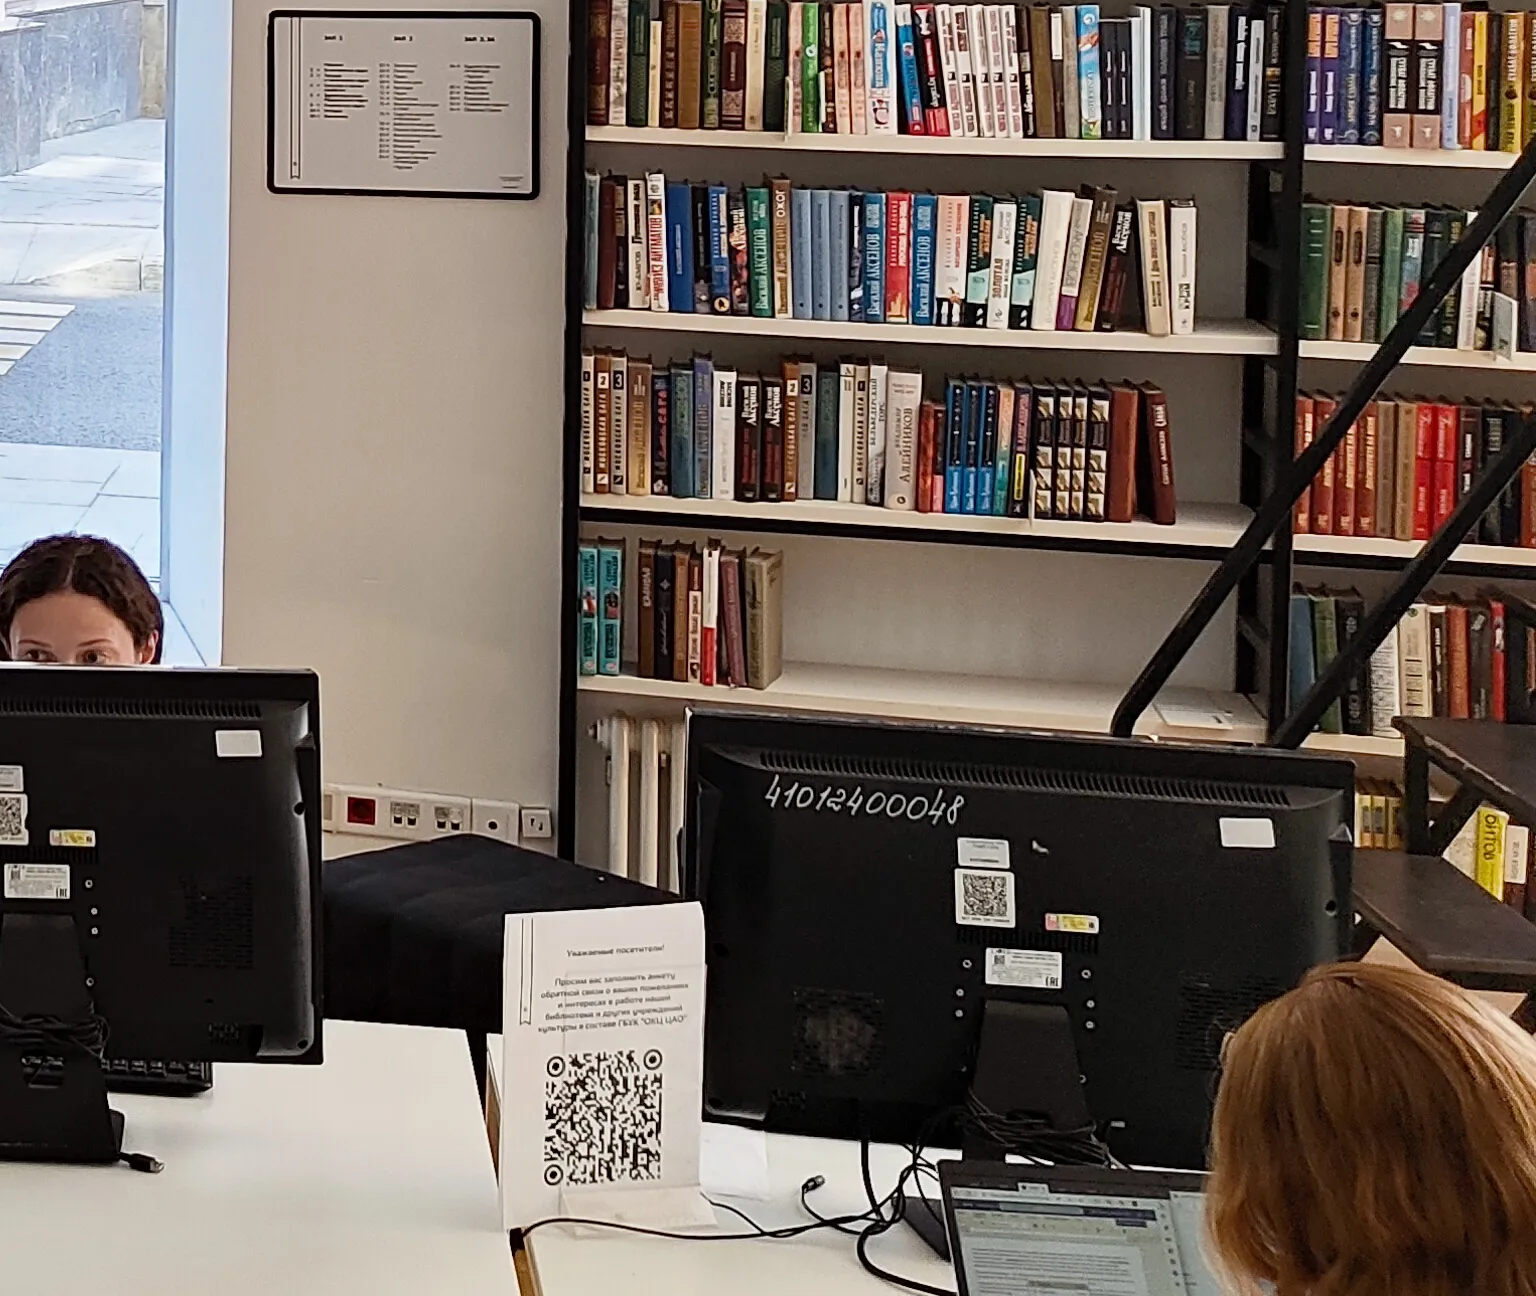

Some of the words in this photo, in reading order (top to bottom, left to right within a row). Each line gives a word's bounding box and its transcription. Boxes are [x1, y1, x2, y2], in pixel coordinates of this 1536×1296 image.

[600, 375, 607, 386] 2
[615, 373, 623, 388] 3
[803, 378, 810, 392] 3
[899, 408, 913, 482] АЛЕЙНИКОВ
[764, 775, 966, 825] 41012400048
